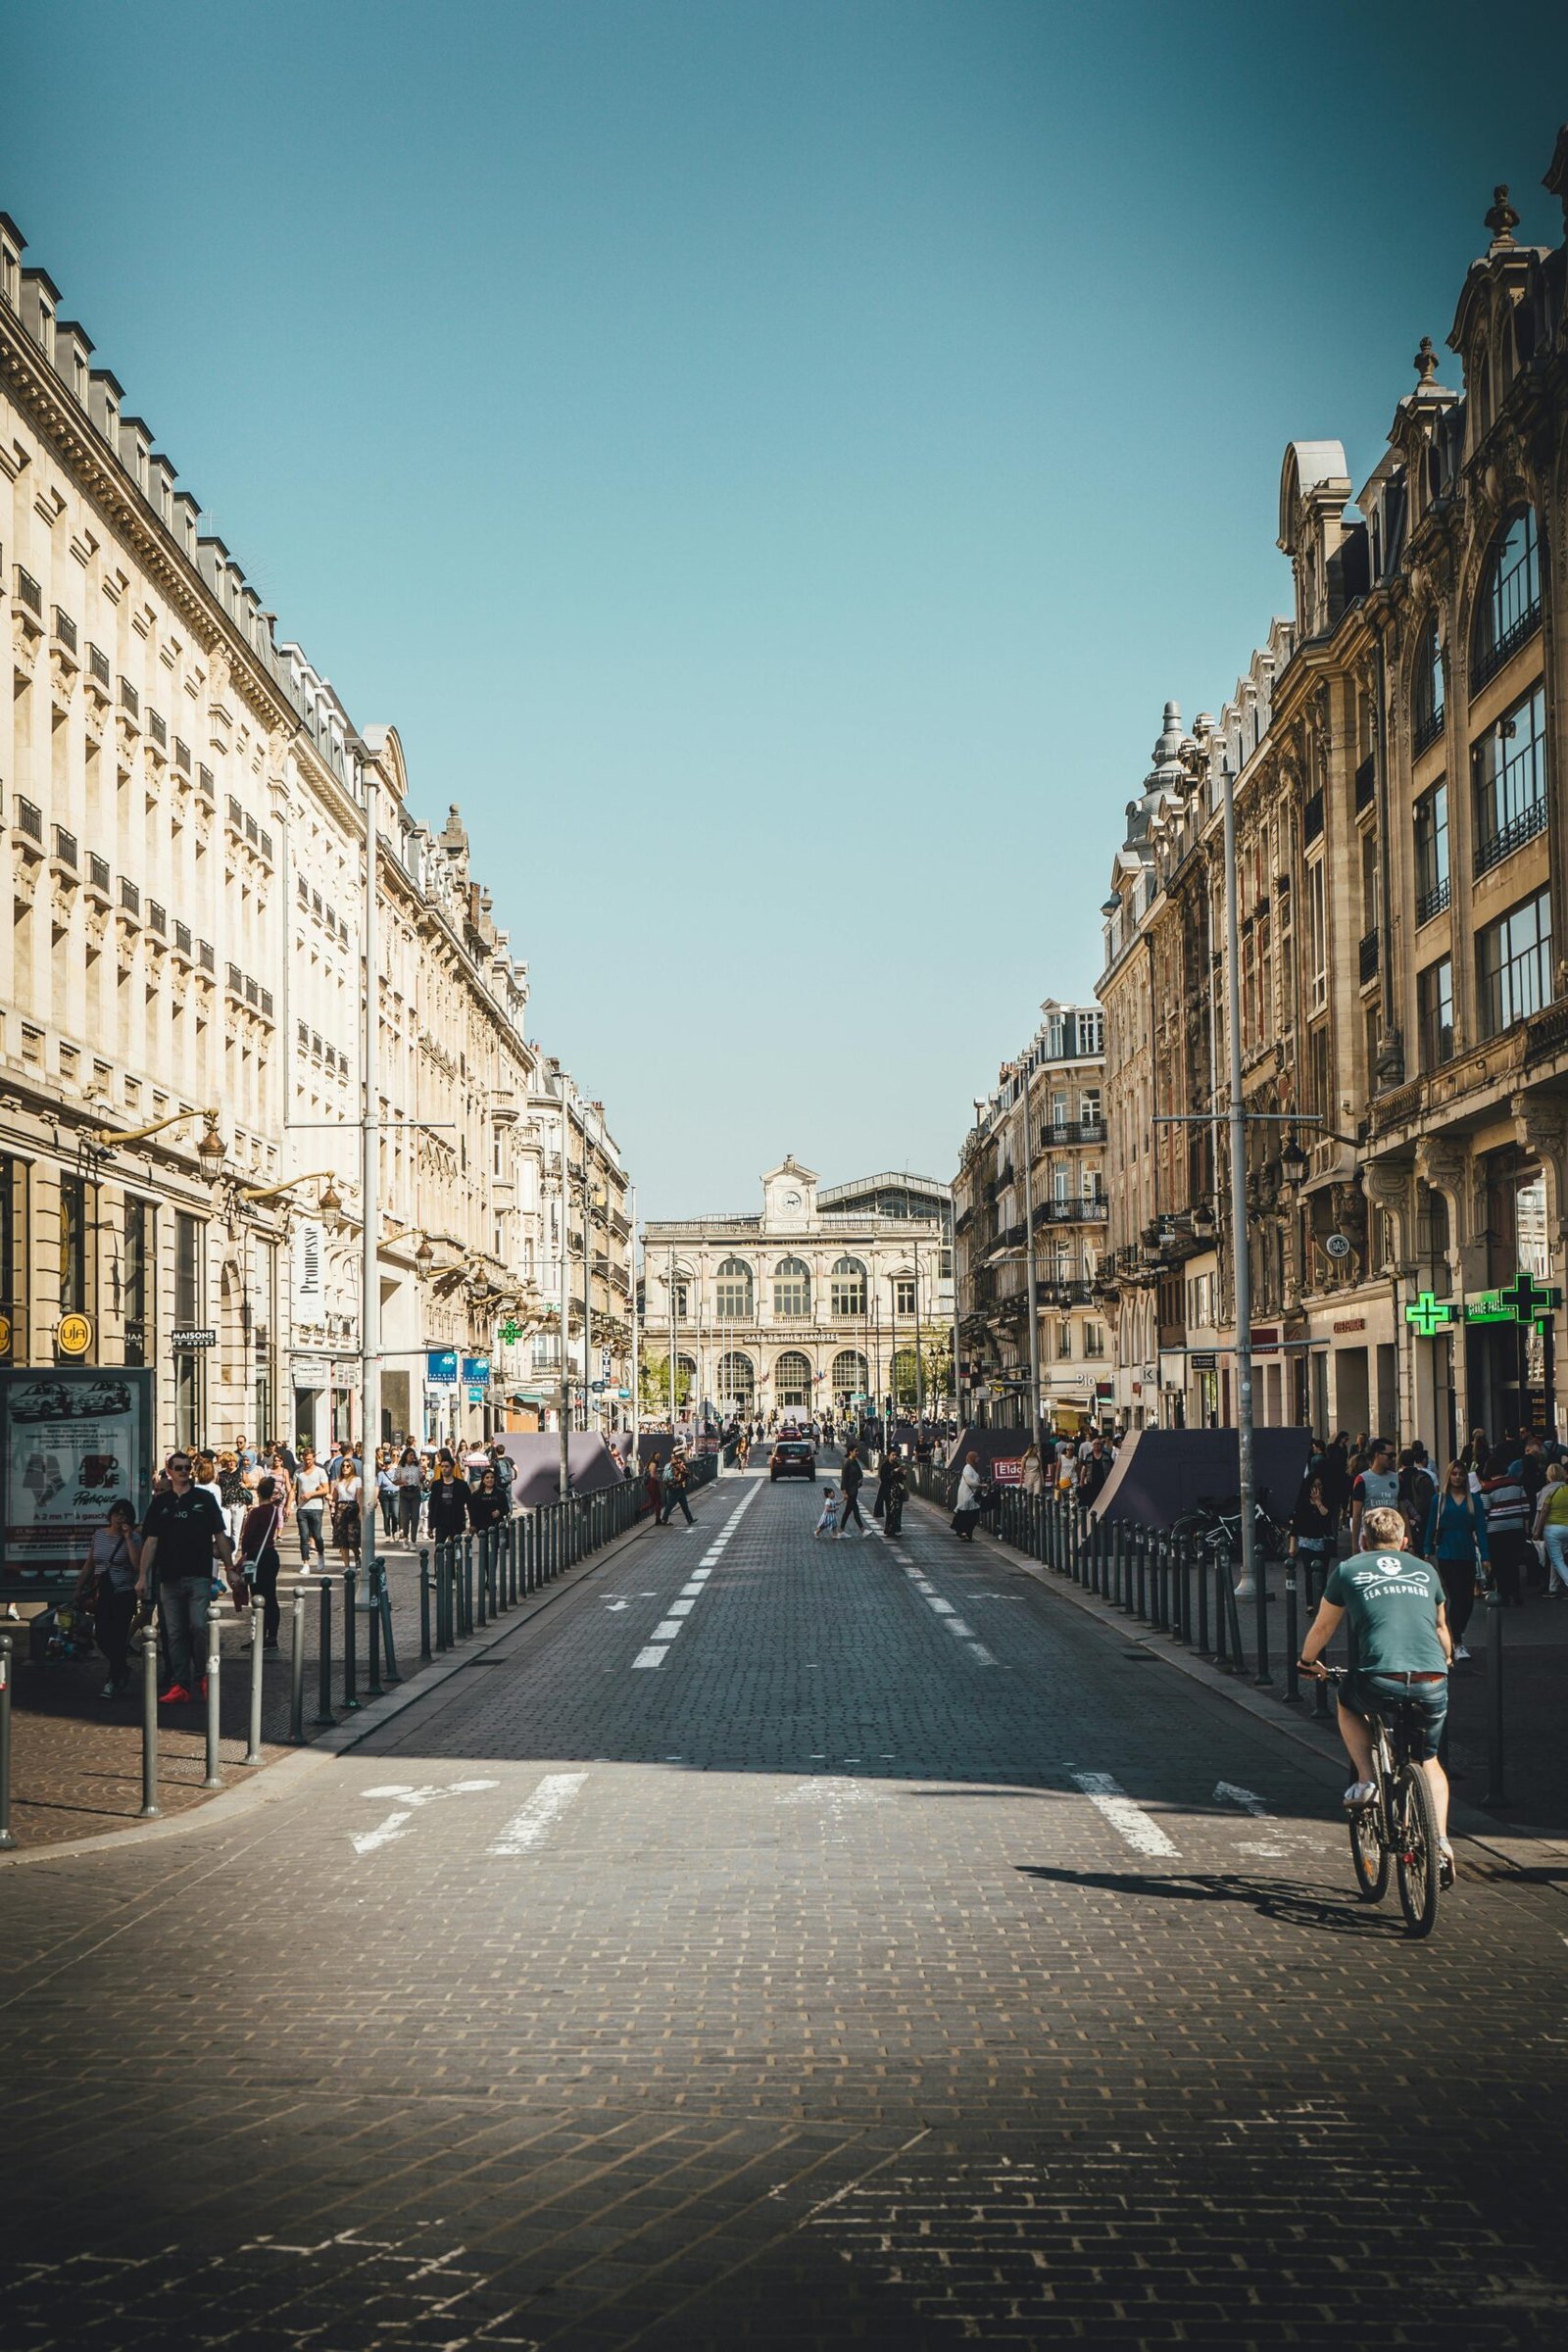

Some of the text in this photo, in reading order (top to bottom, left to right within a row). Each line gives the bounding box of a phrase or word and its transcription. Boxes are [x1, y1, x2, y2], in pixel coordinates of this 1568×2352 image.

[300, 1227, 318, 1294] Promesse
[1076, 1373, 1096, 1388] Bio
[82, 1512, 109, 1521] gauch
[1363, 1585, 1429, 1601] SEA SHEPHERD
